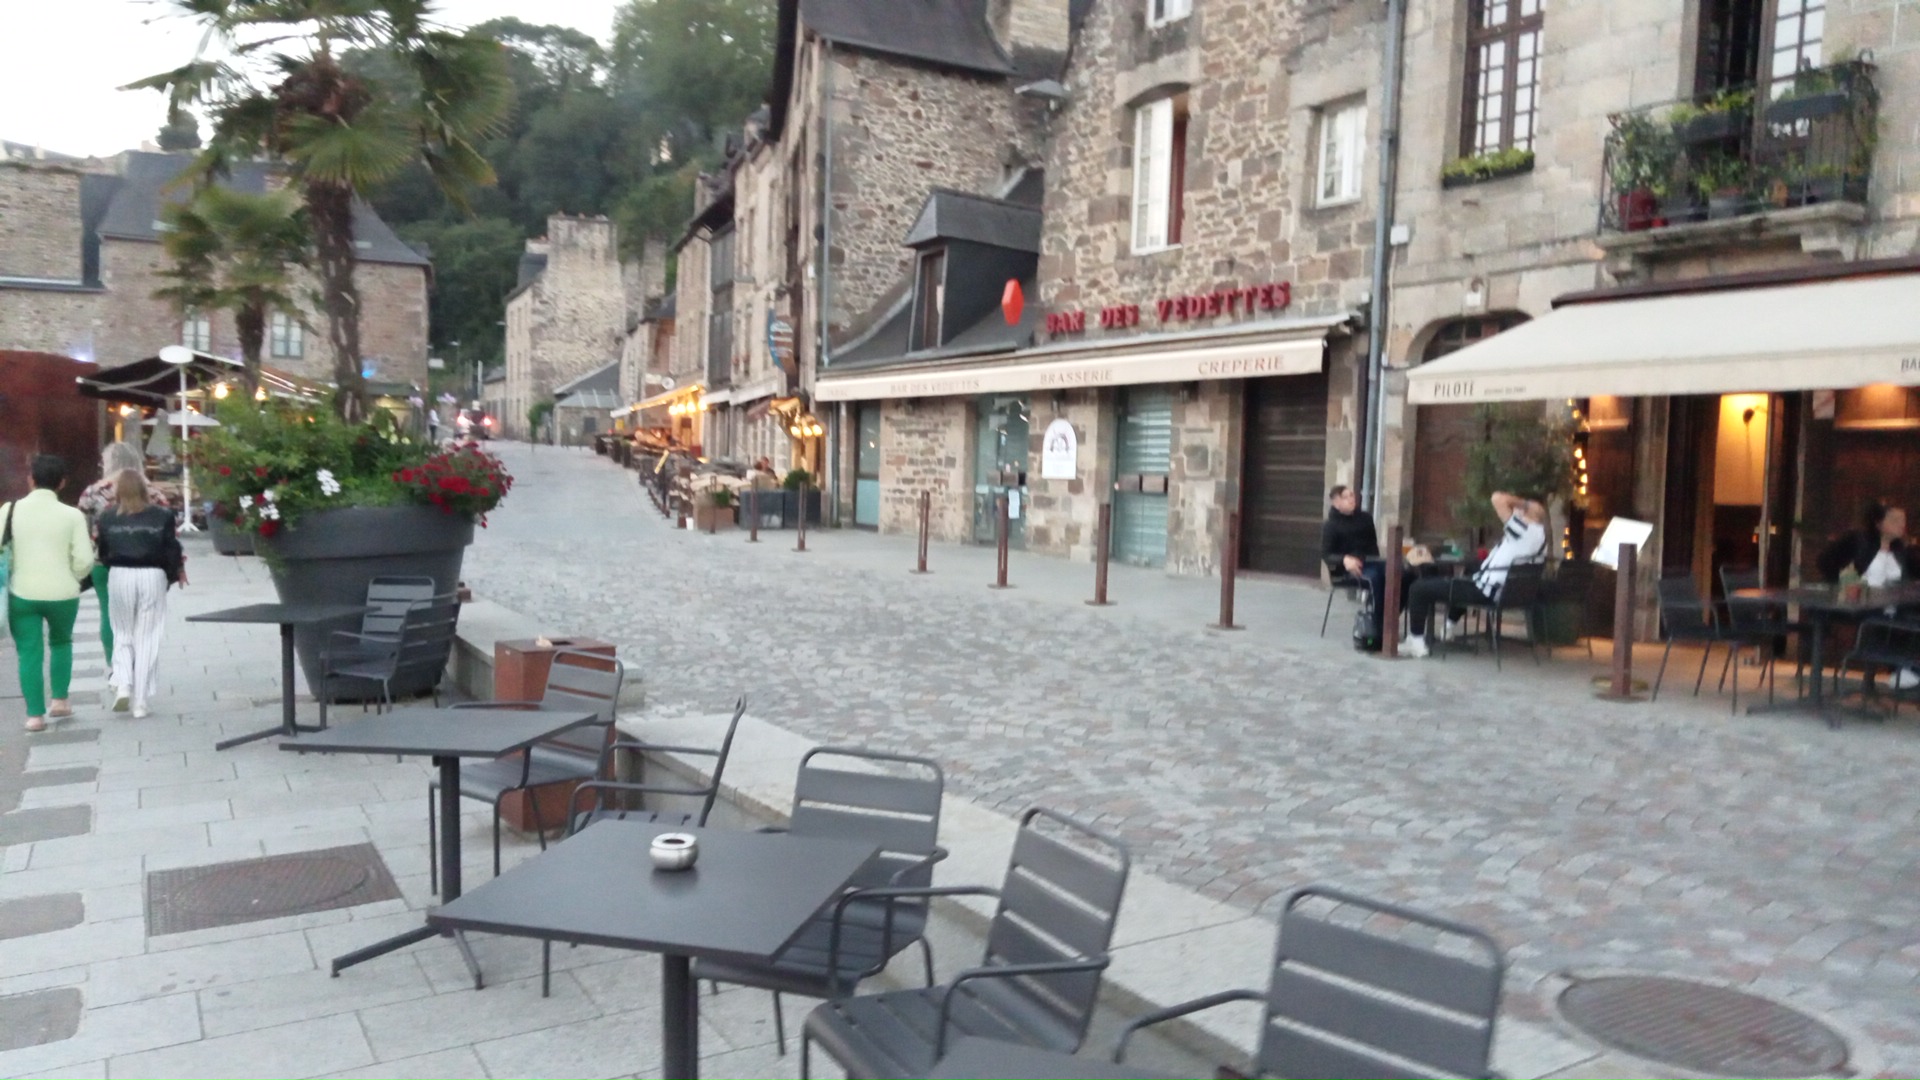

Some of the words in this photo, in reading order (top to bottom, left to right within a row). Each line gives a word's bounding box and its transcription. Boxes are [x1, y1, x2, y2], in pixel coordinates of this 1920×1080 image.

[1046, 311, 1085, 334] BAR
[1101, 304, 1139, 329] DES
[1157, 281, 1291, 322] VEDETTES
[1040, 370, 1113, 385] BRASSERIE
